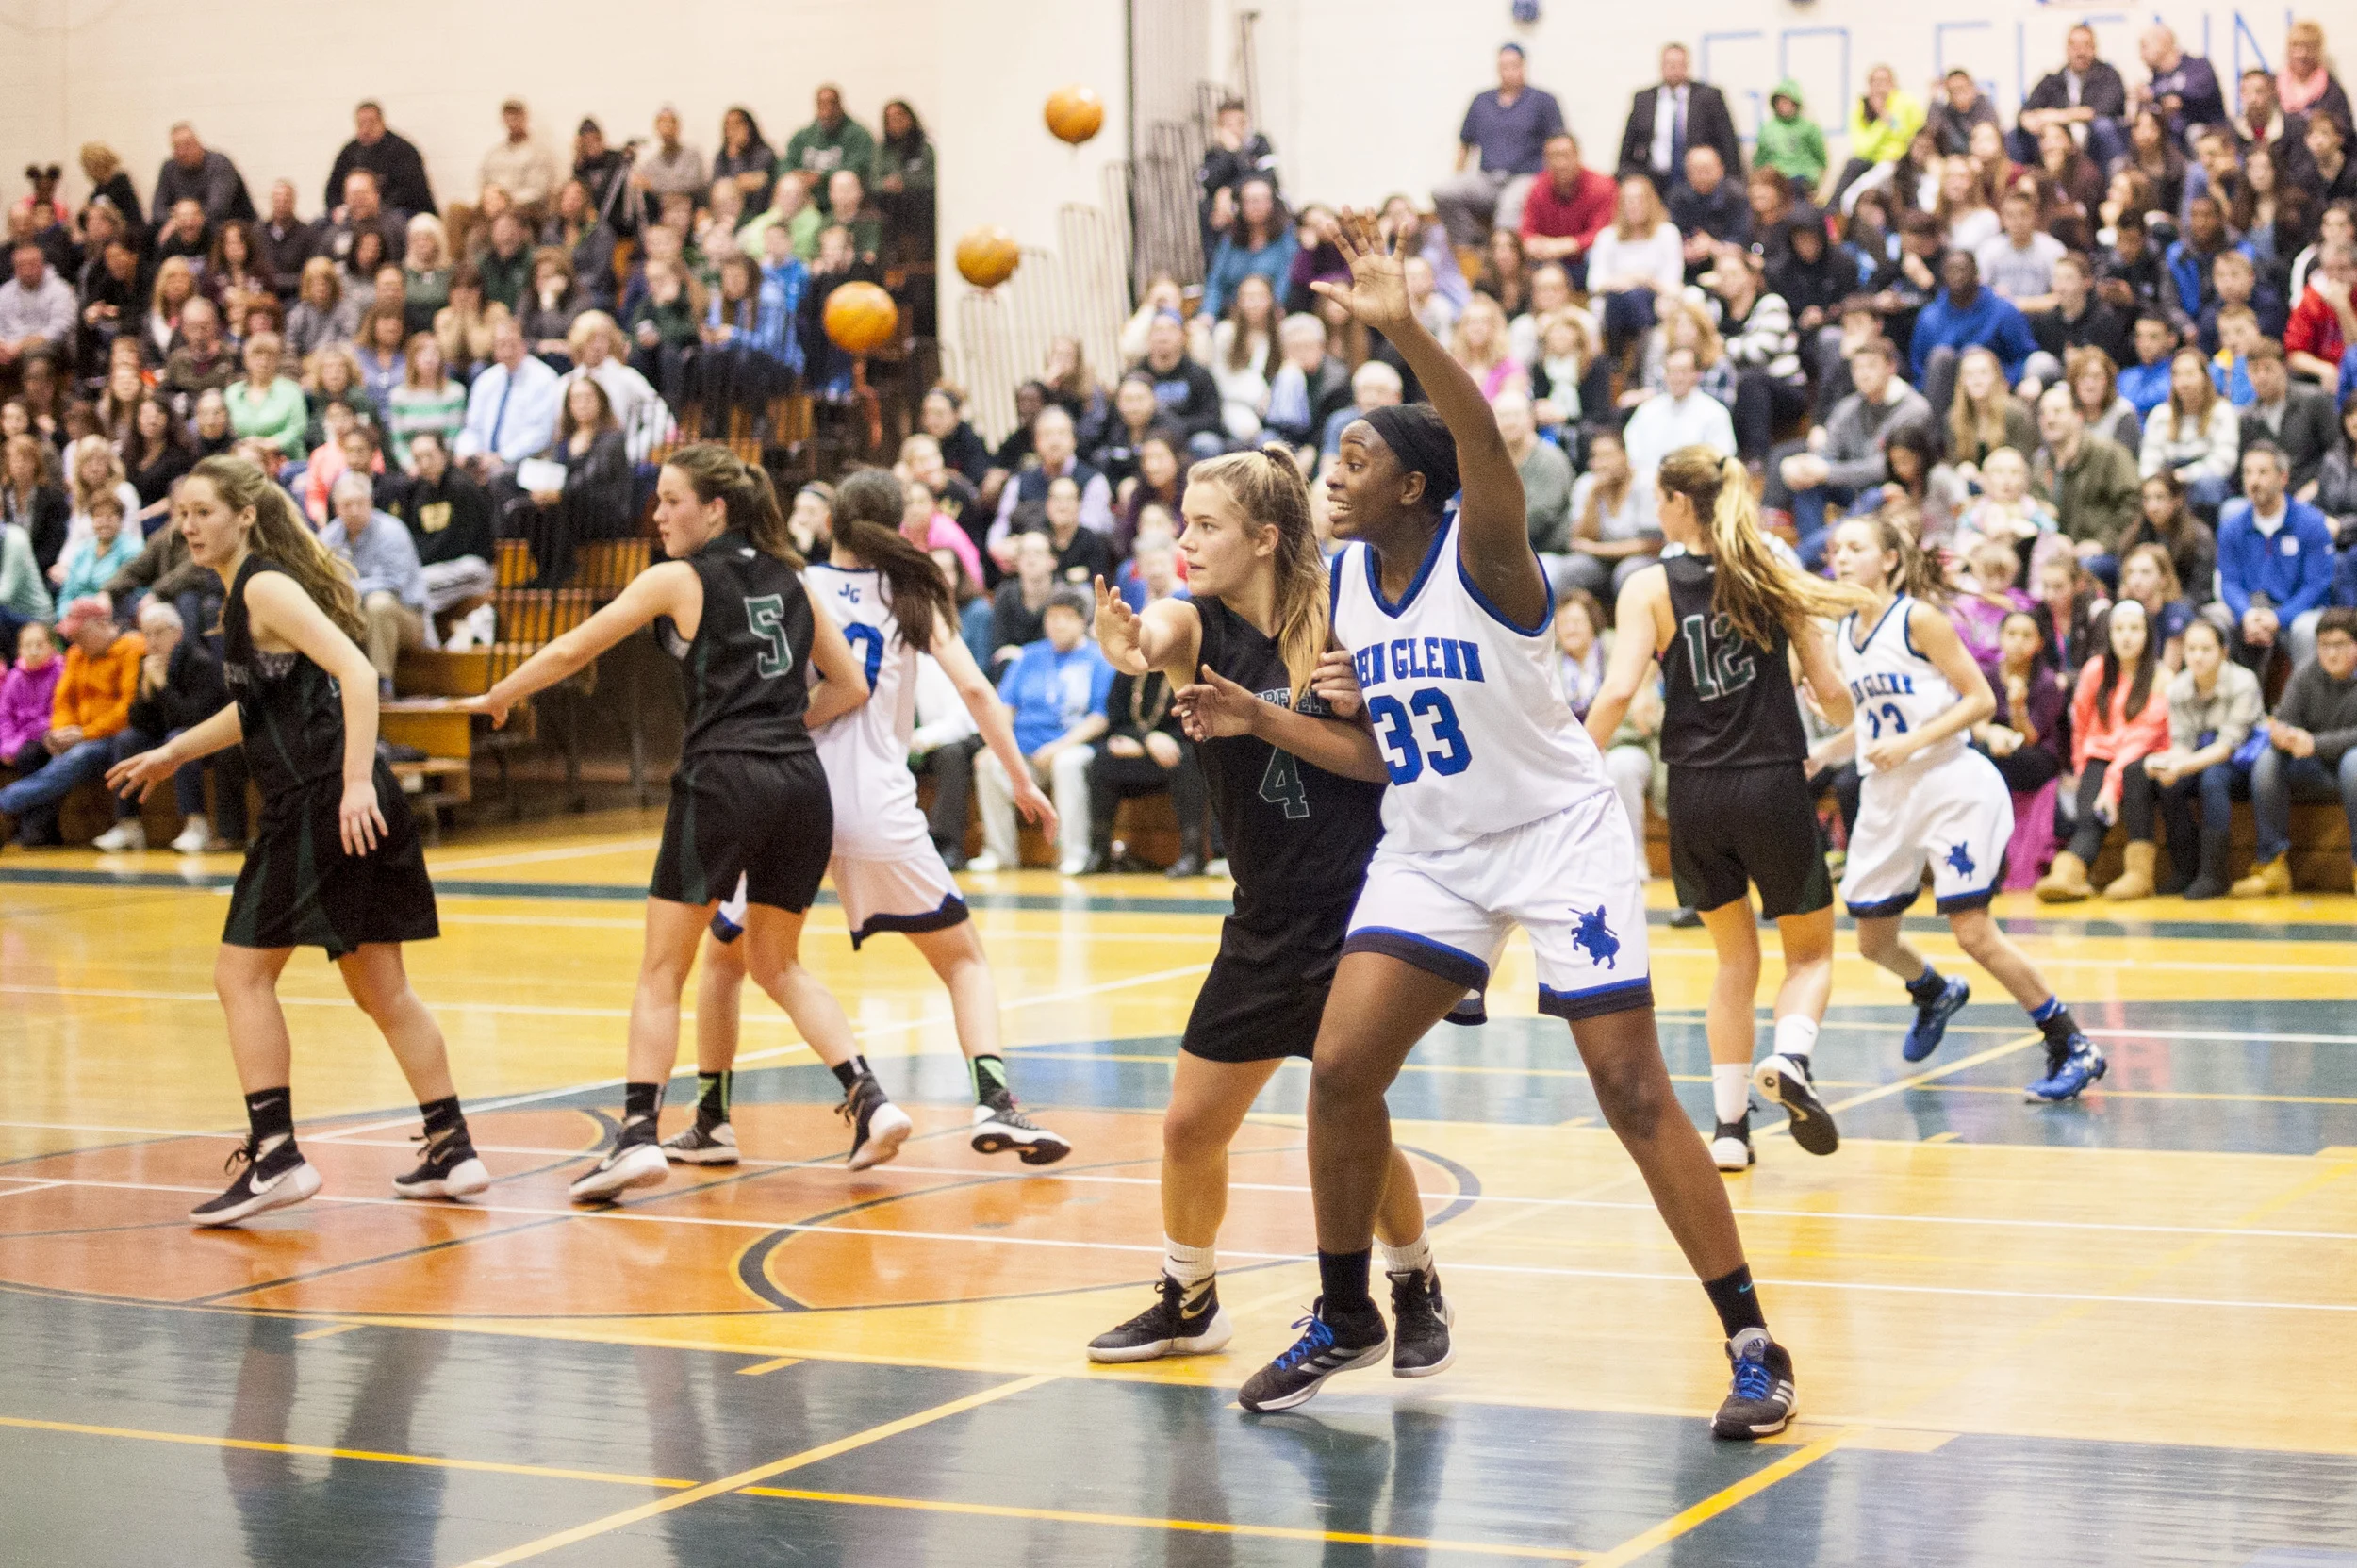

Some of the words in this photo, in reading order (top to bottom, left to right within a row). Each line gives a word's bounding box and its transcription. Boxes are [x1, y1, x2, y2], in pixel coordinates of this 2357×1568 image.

[837, 582, 862, 604] JG
[742, 593, 794, 680] 5
[1351, 642, 1386, 689] HN
[1391, 636, 1485, 683] GLENN
[1682, 611, 1757, 702] 12
[1368, 686, 1473, 786] 33
[1259, 746, 1310, 818] 4
